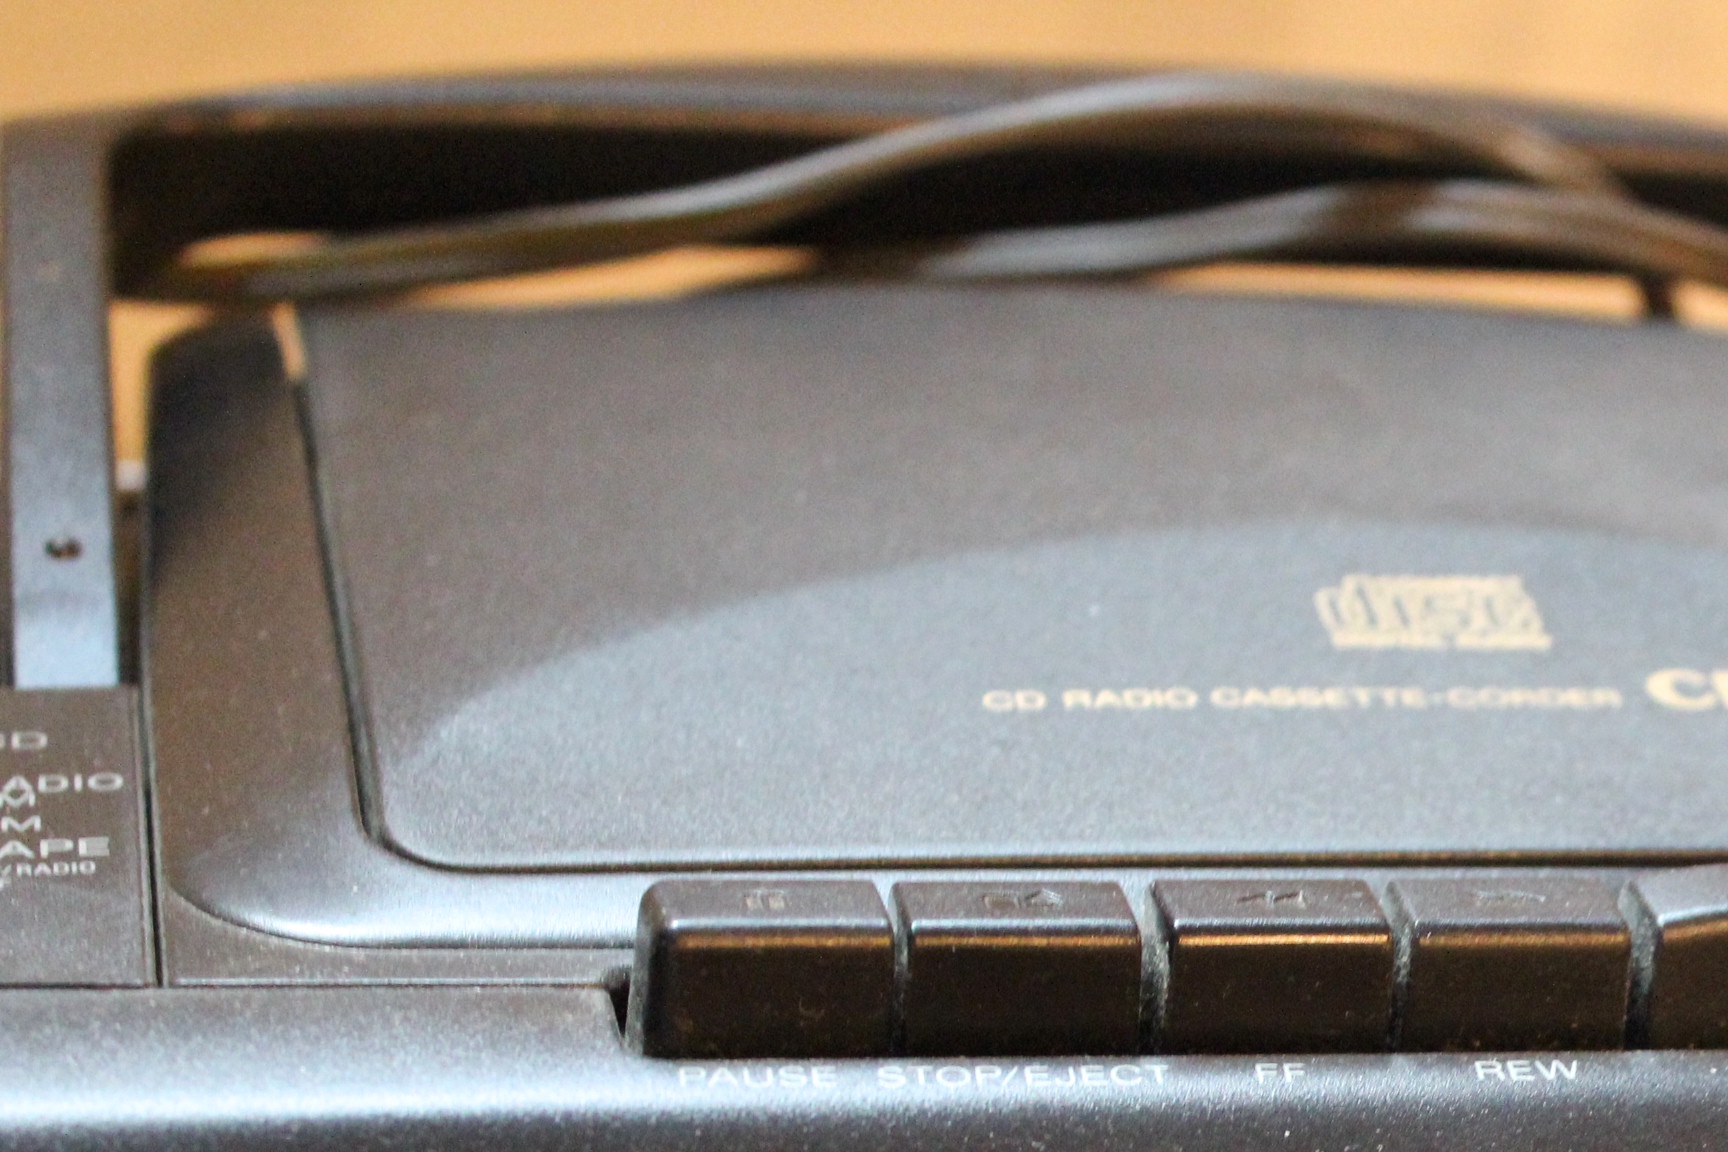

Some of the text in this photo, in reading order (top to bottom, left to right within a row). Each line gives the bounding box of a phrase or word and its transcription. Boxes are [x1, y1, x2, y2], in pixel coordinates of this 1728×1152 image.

[1062, 687, 1198, 711] RADIO
[677, 1064, 838, 1089] PAUSE
[877, 1063, 1170, 1087] STOP/EJECT
[1254, 1062, 1307, 1083] FF
[1474, 1060, 1580, 1082] REW
